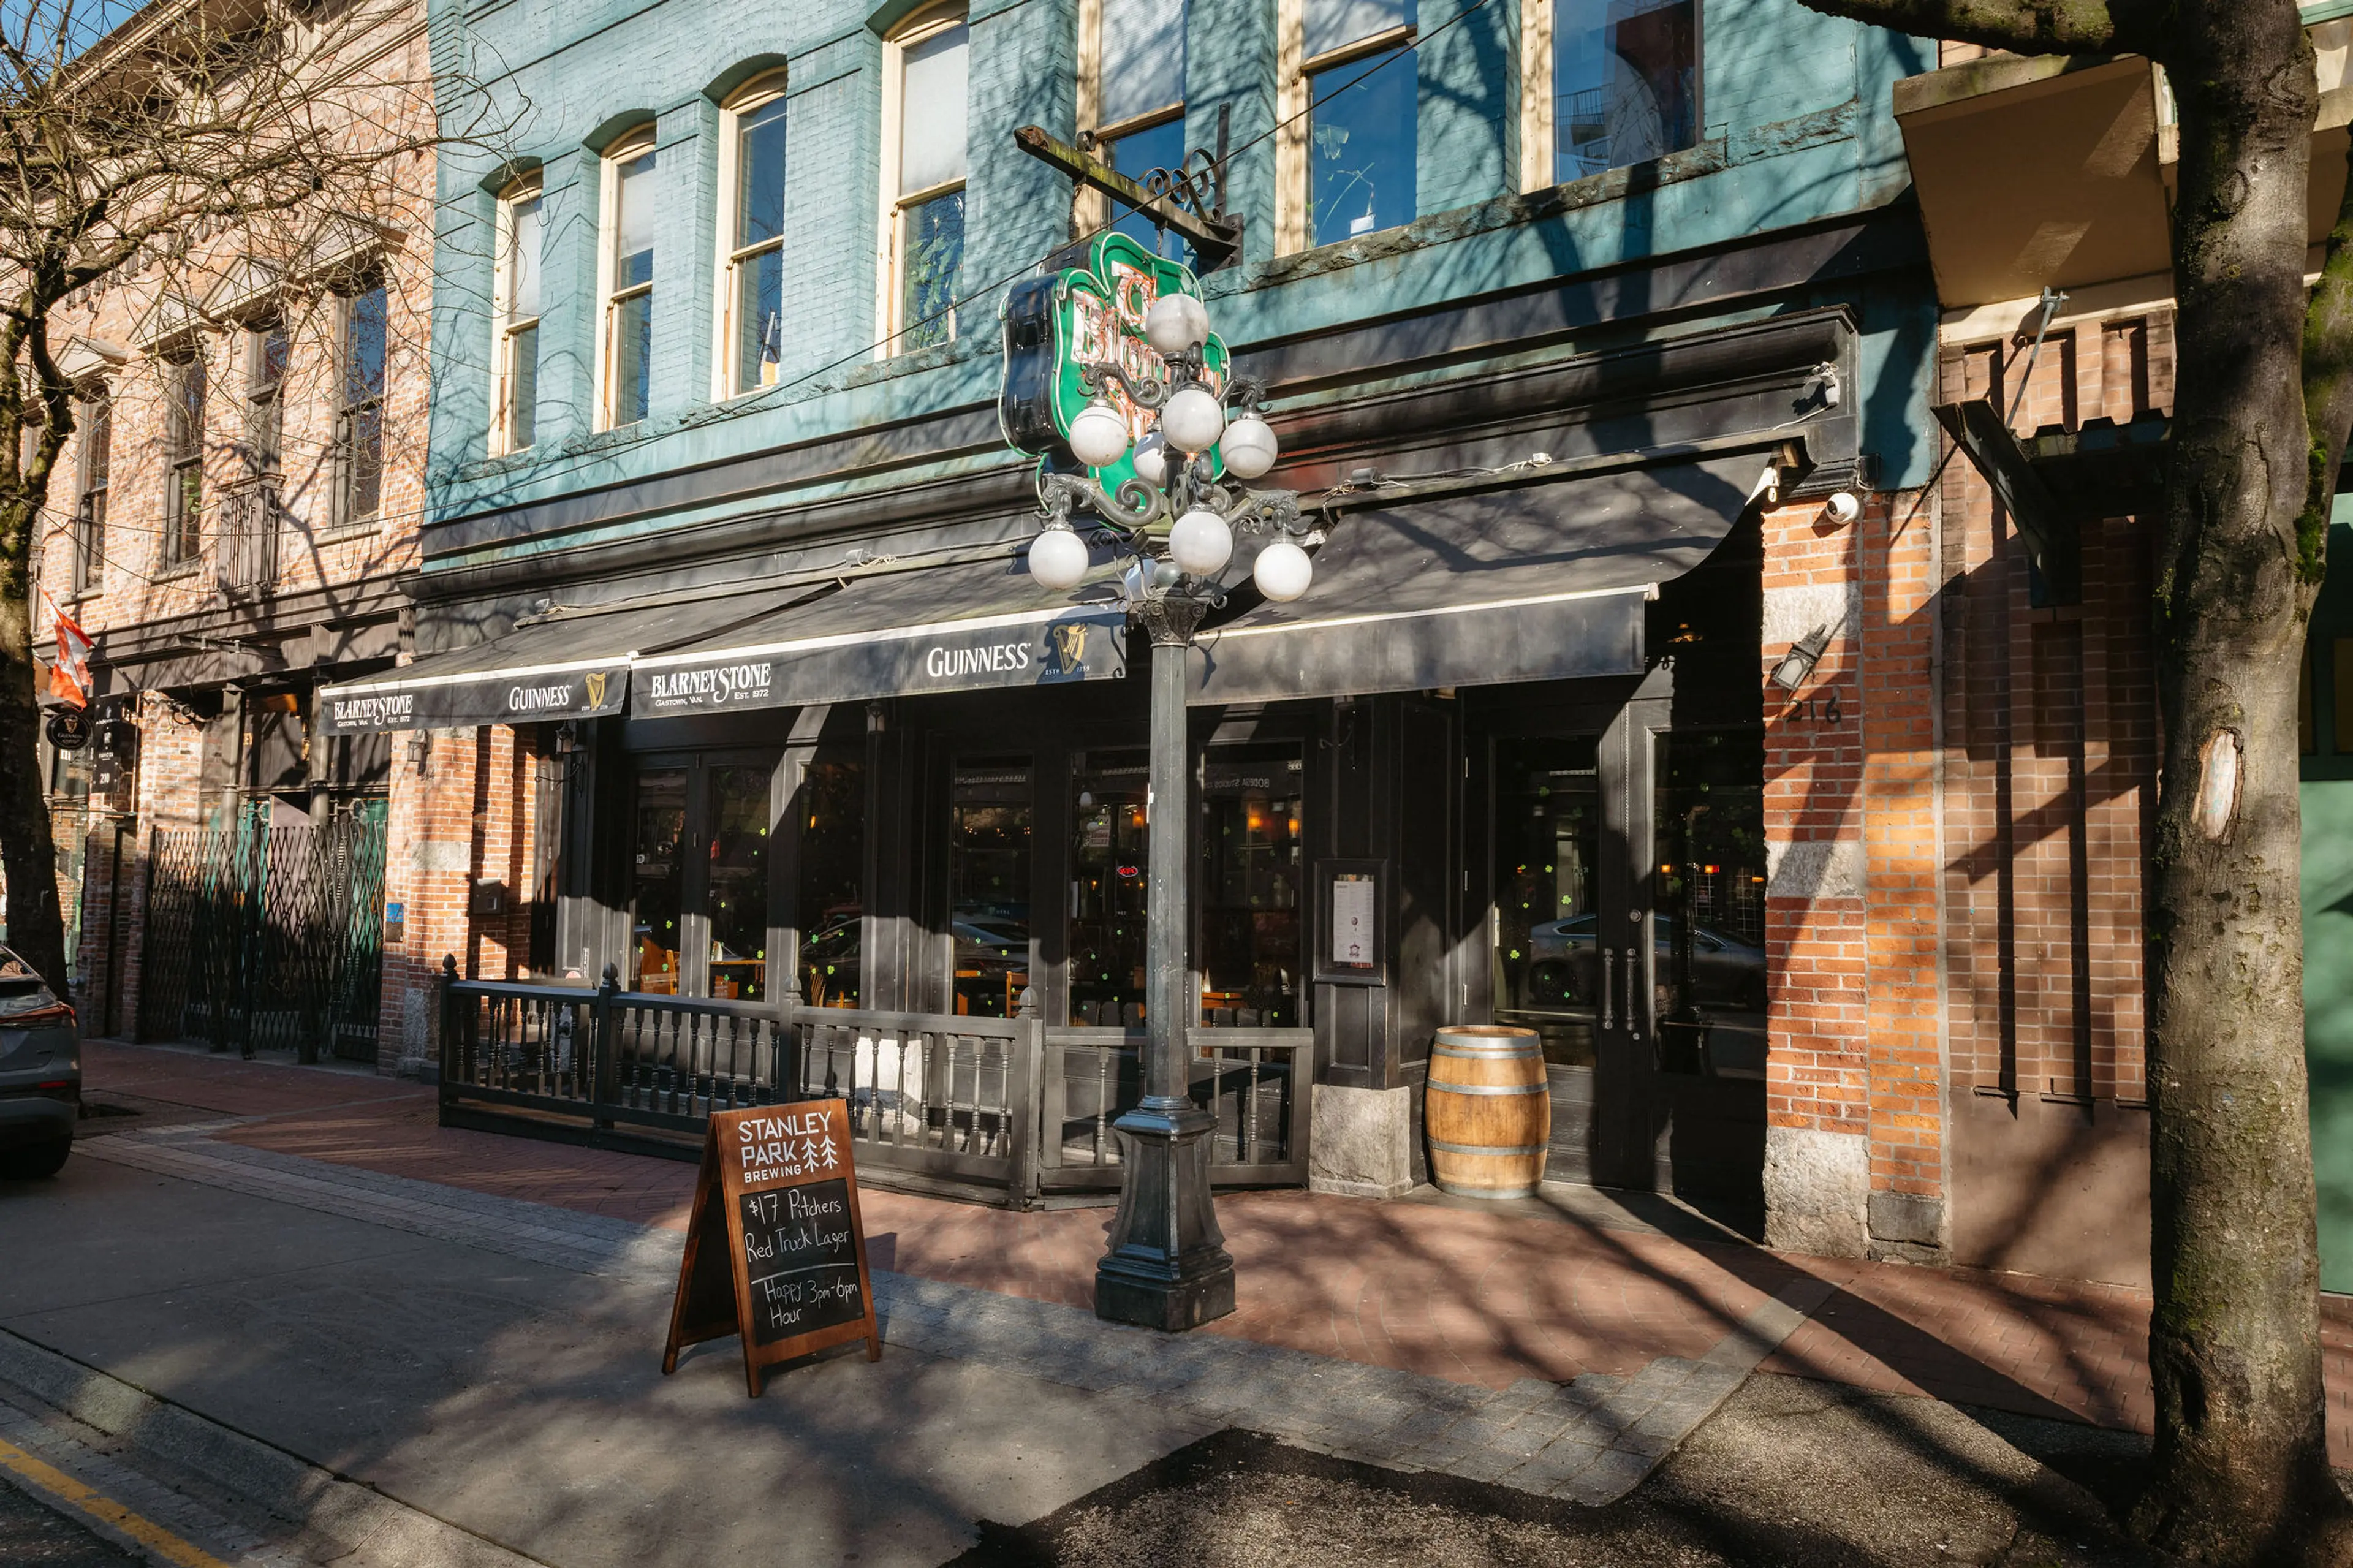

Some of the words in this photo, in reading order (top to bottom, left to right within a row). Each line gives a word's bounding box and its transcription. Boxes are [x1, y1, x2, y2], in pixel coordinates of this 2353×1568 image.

[926, 643, 1029, 677] GUINNESS
[509, 685, 570, 711] GUINNESS
[1787, 697, 1841, 723] 216
[738, 1110, 832, 1143] STANLEY
[741, 1139, 798, 1168] PARK
[744, 1164, 802, 1183] BREWING
[749, 1193, 779, 1225] $17
[788, 1189, 842, 1219] Pitchers
[745, 1232, 774, 1263] Red
[775, 1227, 813, 1253] Truck
[814, 1222, 850, 1254] Lager
[763, 1279, 803, 1305] Happy
[770, 1304, 803, 1328] Hour
